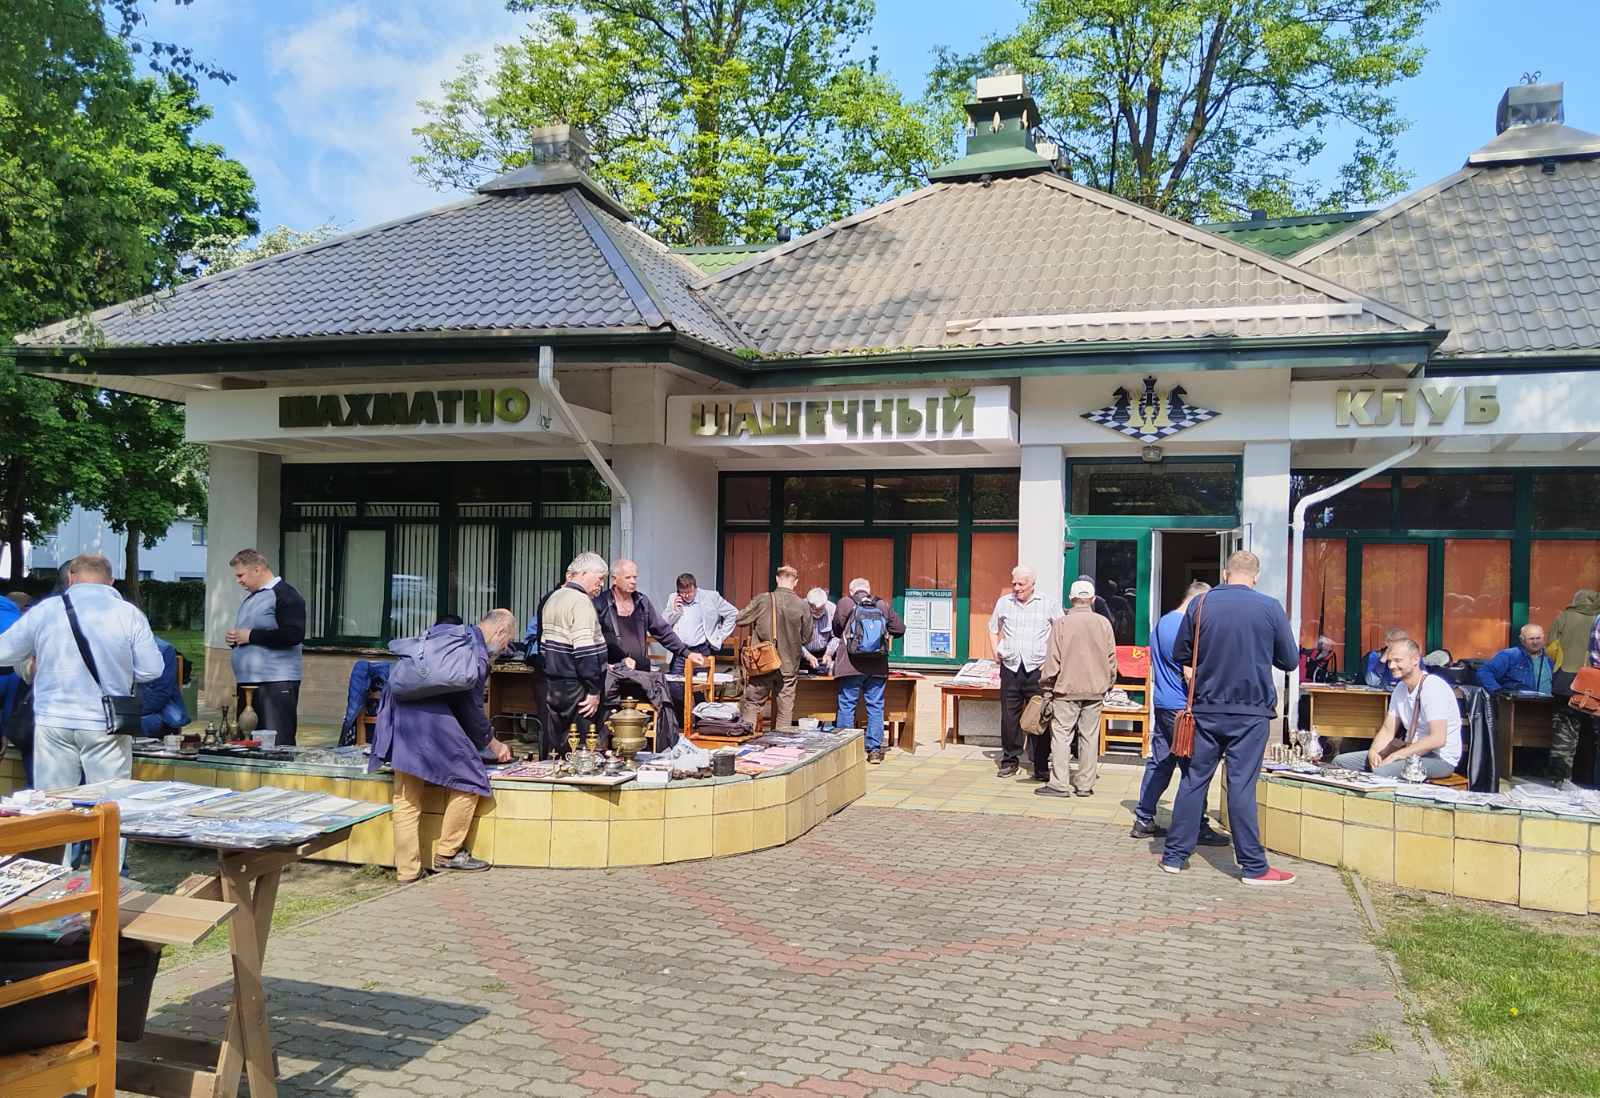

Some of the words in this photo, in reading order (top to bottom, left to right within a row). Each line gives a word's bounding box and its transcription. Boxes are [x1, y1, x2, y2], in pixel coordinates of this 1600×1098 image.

[279, 387, 531, 428] ШАХМАТНО
[690, 387, 976, 436] ШАШЕЧНЫЙ
[1336, 385, 1500, 427] КЛУБ
